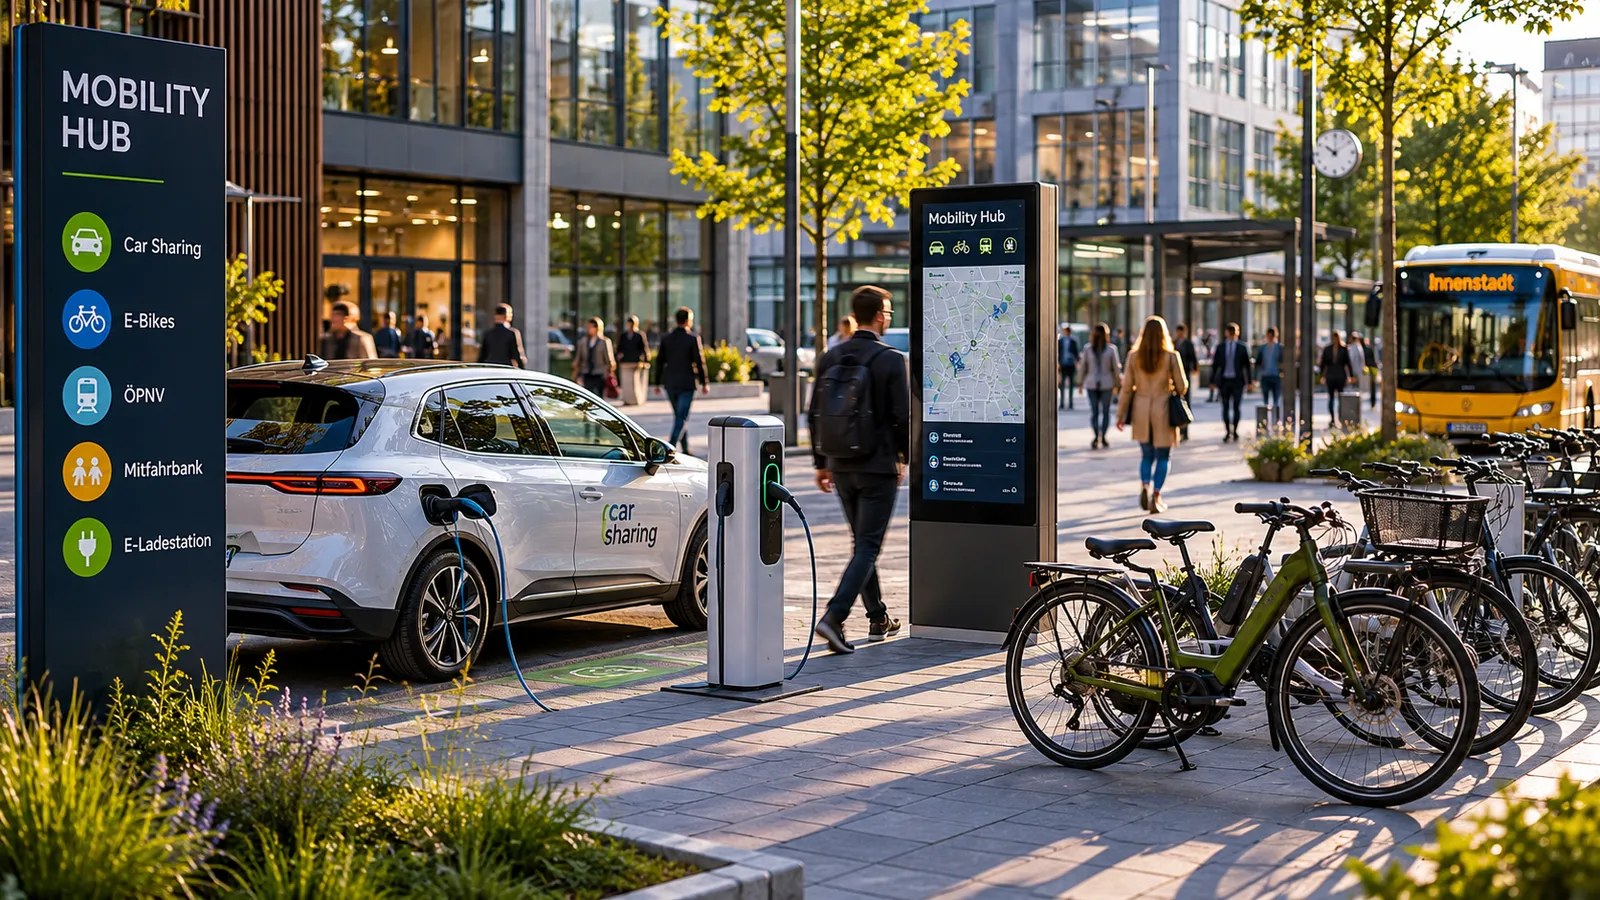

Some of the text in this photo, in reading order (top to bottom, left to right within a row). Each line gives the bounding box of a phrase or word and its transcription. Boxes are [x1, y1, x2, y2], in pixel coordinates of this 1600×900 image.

[62, 70, 210, 118] MOBILITY
[62, 115, 131, 153] HUB
[928, 209, 1006, 227] Mobility Hub
[124, 236, 202, 260] Car Sharing
[1429, 272, 1515, 291] Innenstadt
[124, 312, 175, 329] E-Bikes
[124, 384, 165, 404] ÖPNV
[124, 459, 203, 478] Mitfahrbank
[124, 532, 212, 553] E-Ladestation
[604, 522, 658, 548] sharing
